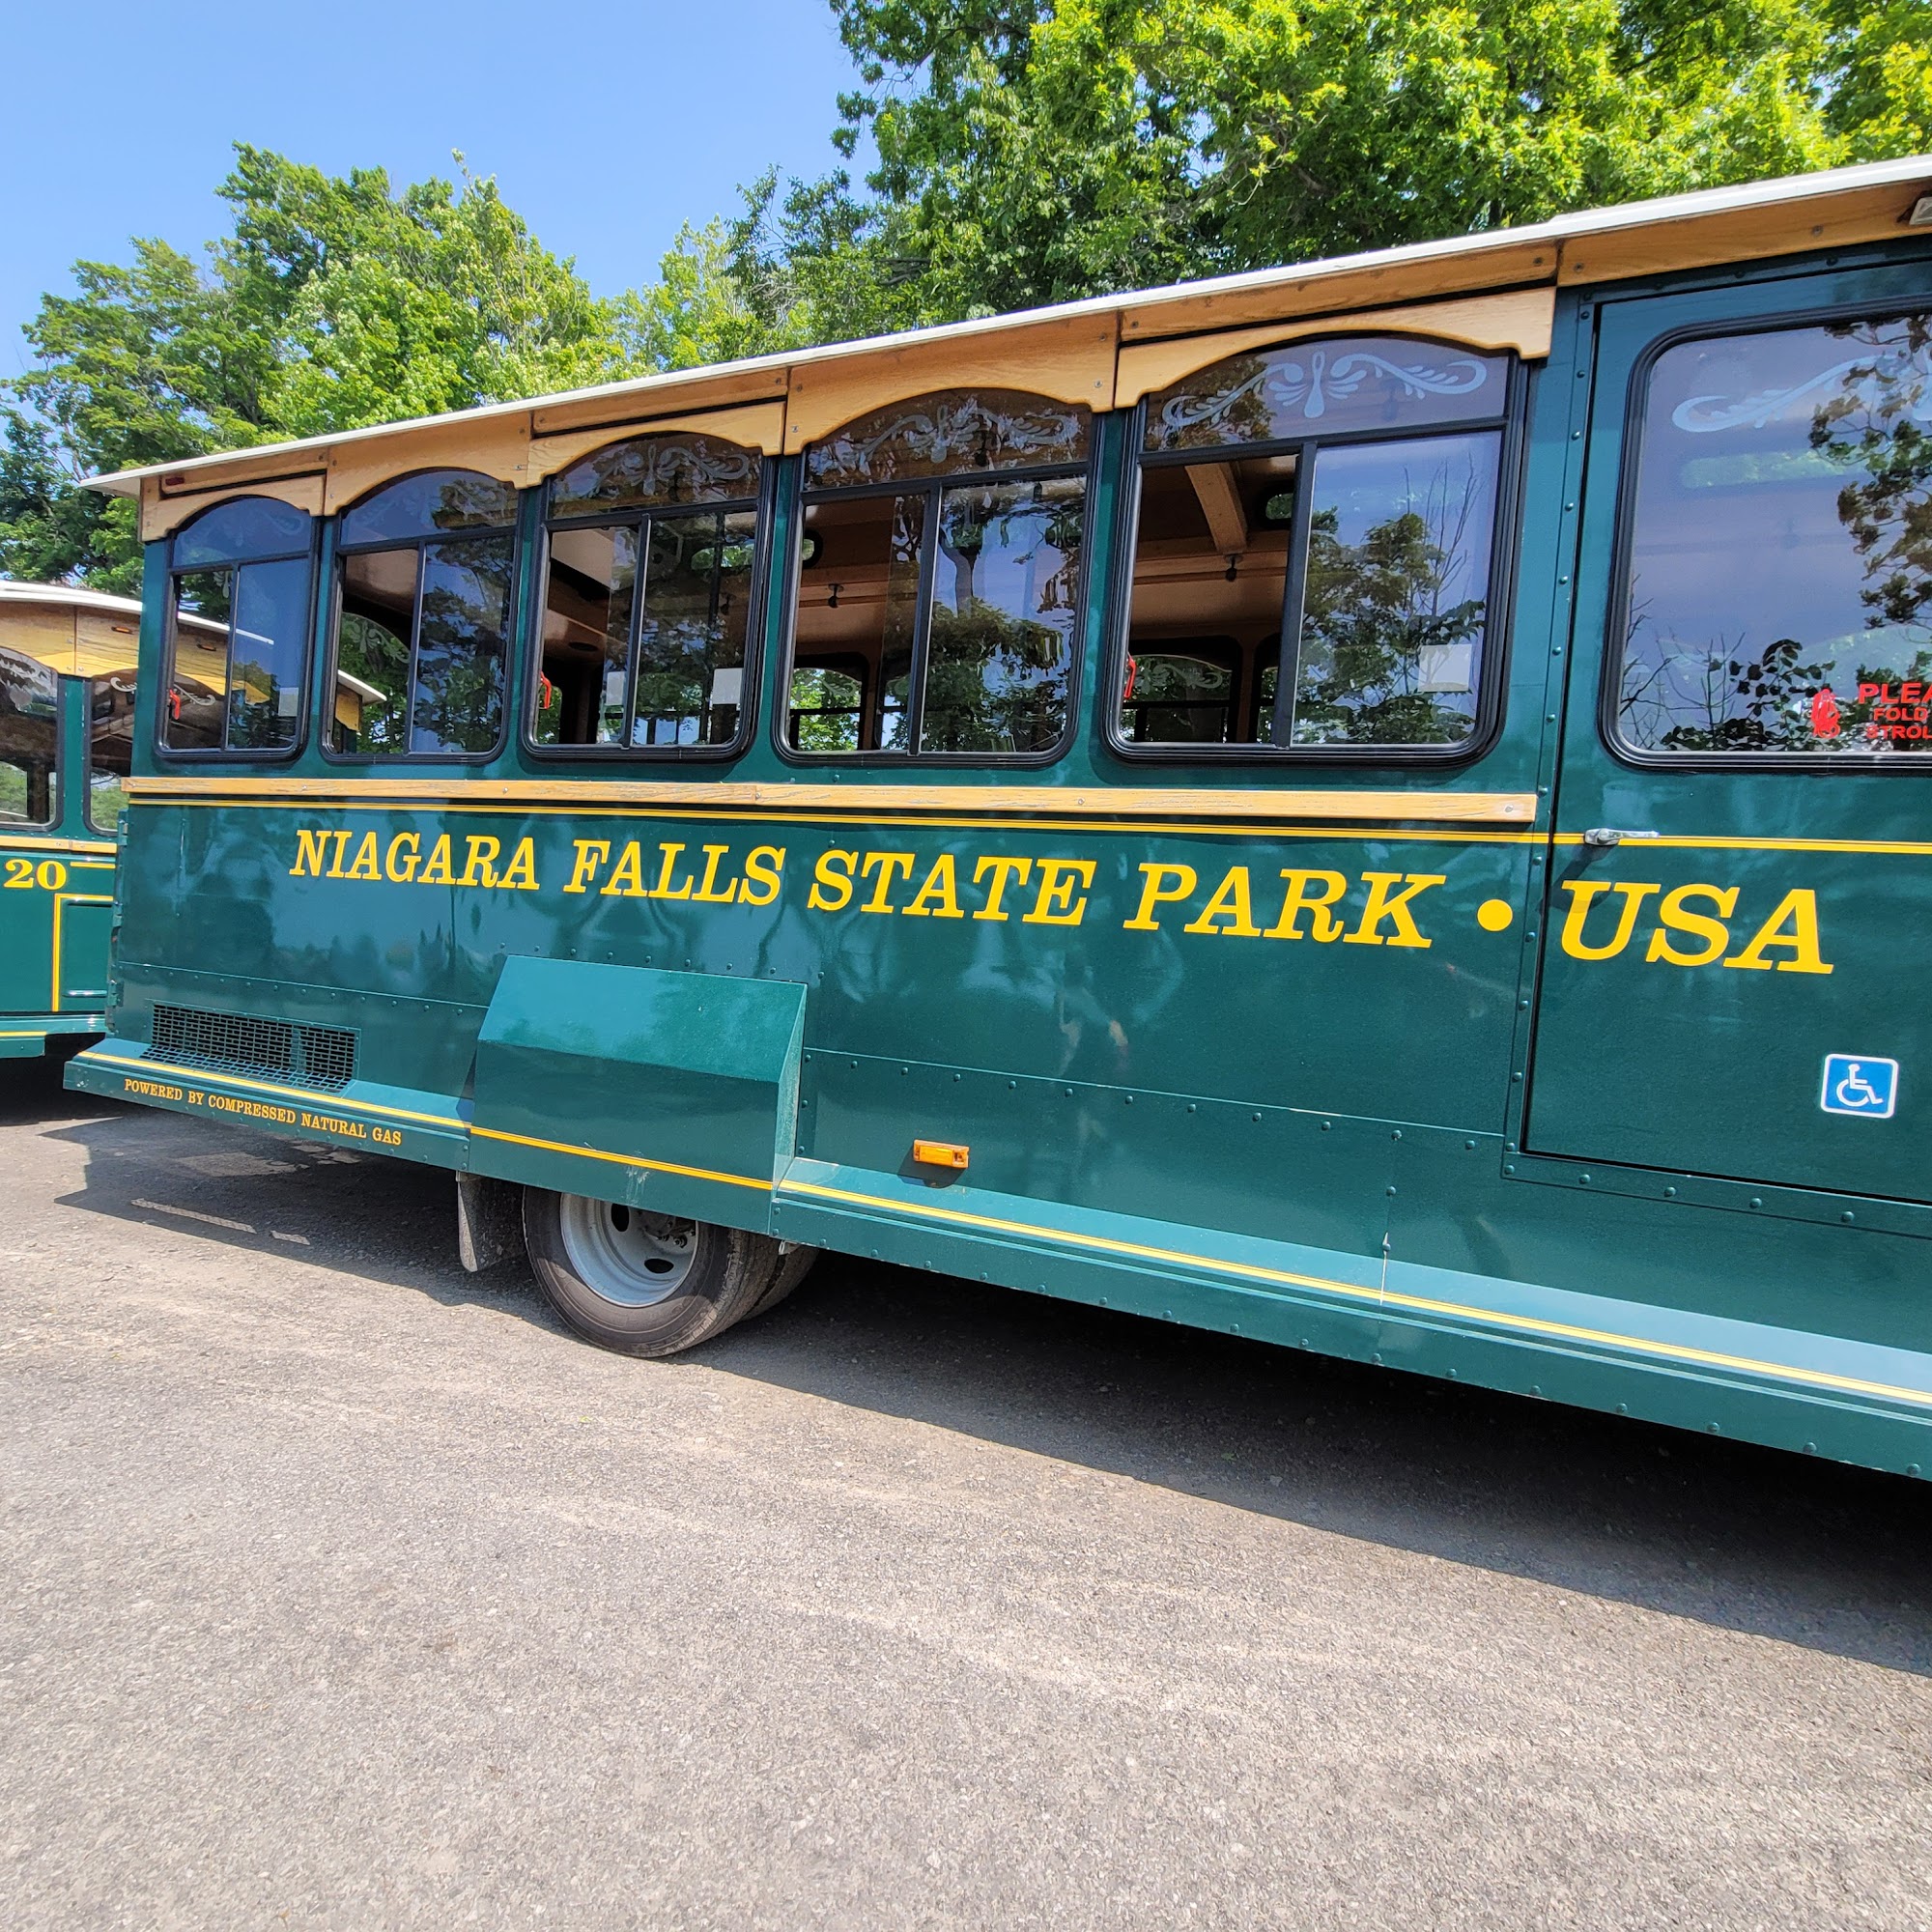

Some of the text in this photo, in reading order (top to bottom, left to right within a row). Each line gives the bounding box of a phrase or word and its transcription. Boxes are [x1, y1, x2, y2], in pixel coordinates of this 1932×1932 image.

[1874, 706, 1929, 723] FOLD
[3, 859, 68, 891] 20
[288, 830, 540, 891] NIAGARA
[562, 838, 786, 907] FALLS
[807, 848, 1097, 927] STATE
[1123, 862, 1447, 950] PARK
[1560, 880, 1833, 976] USA
[124, 1078, 402, 1146] POWERED BY COMPRESSED NATURAL GAS
